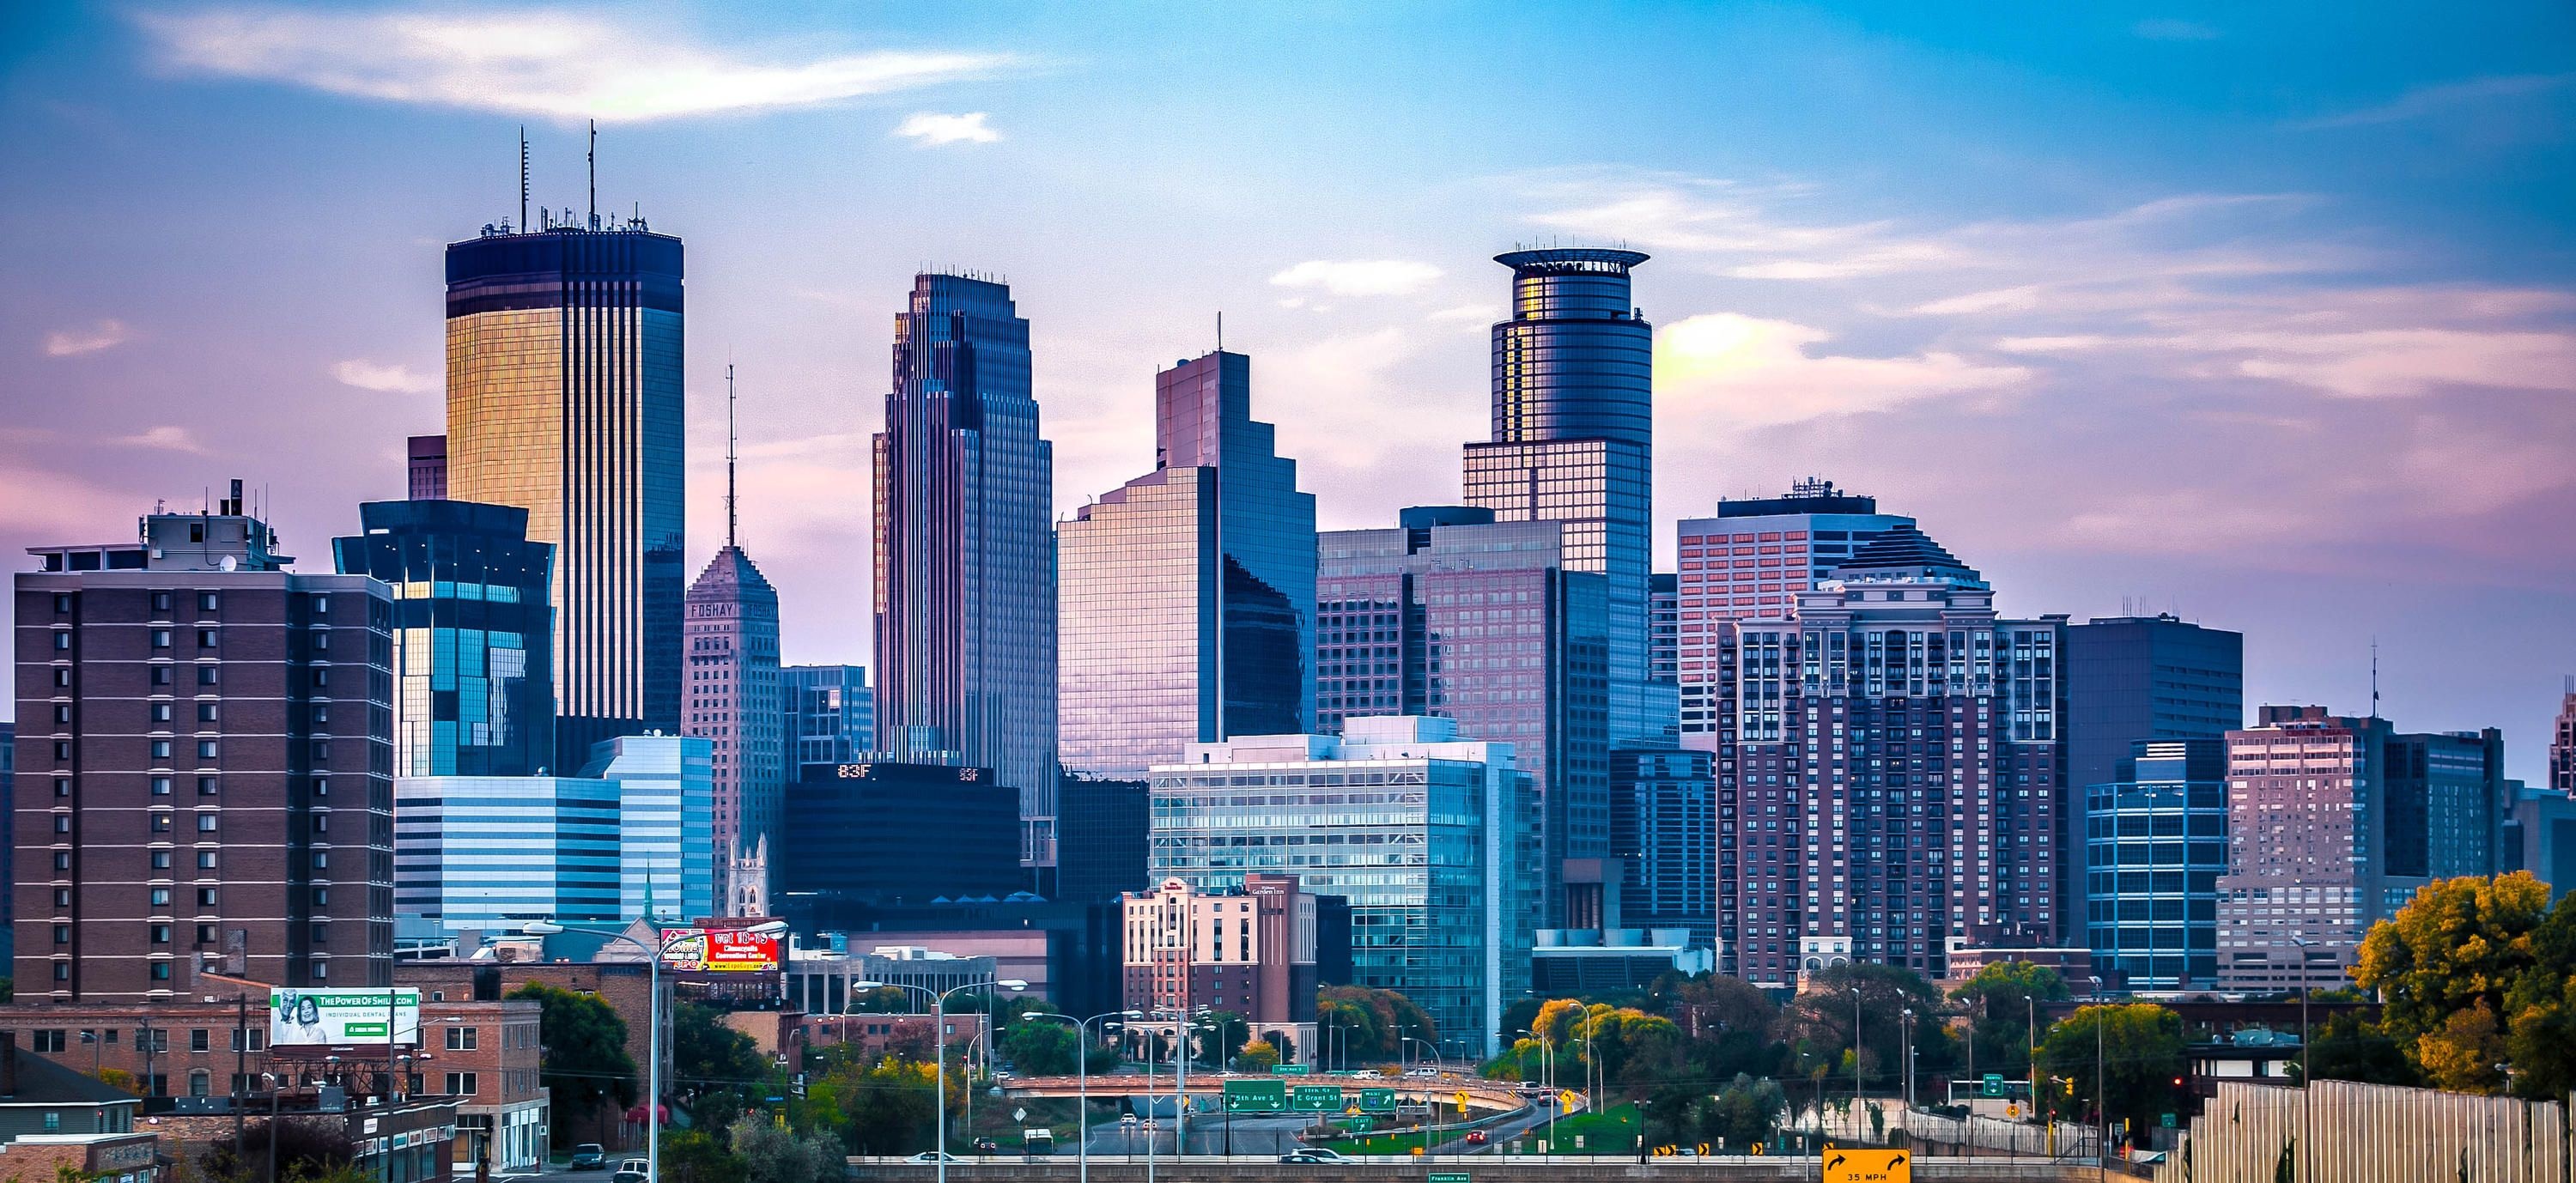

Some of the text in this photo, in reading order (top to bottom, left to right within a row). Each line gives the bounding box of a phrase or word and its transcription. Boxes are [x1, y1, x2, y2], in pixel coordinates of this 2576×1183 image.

[691, 604, 733, 617] FOSHAY
[748, 604, 776, 617] FOSHAY
[319, 996, 412, 1005] THEPOWEROFSMIL.COM
